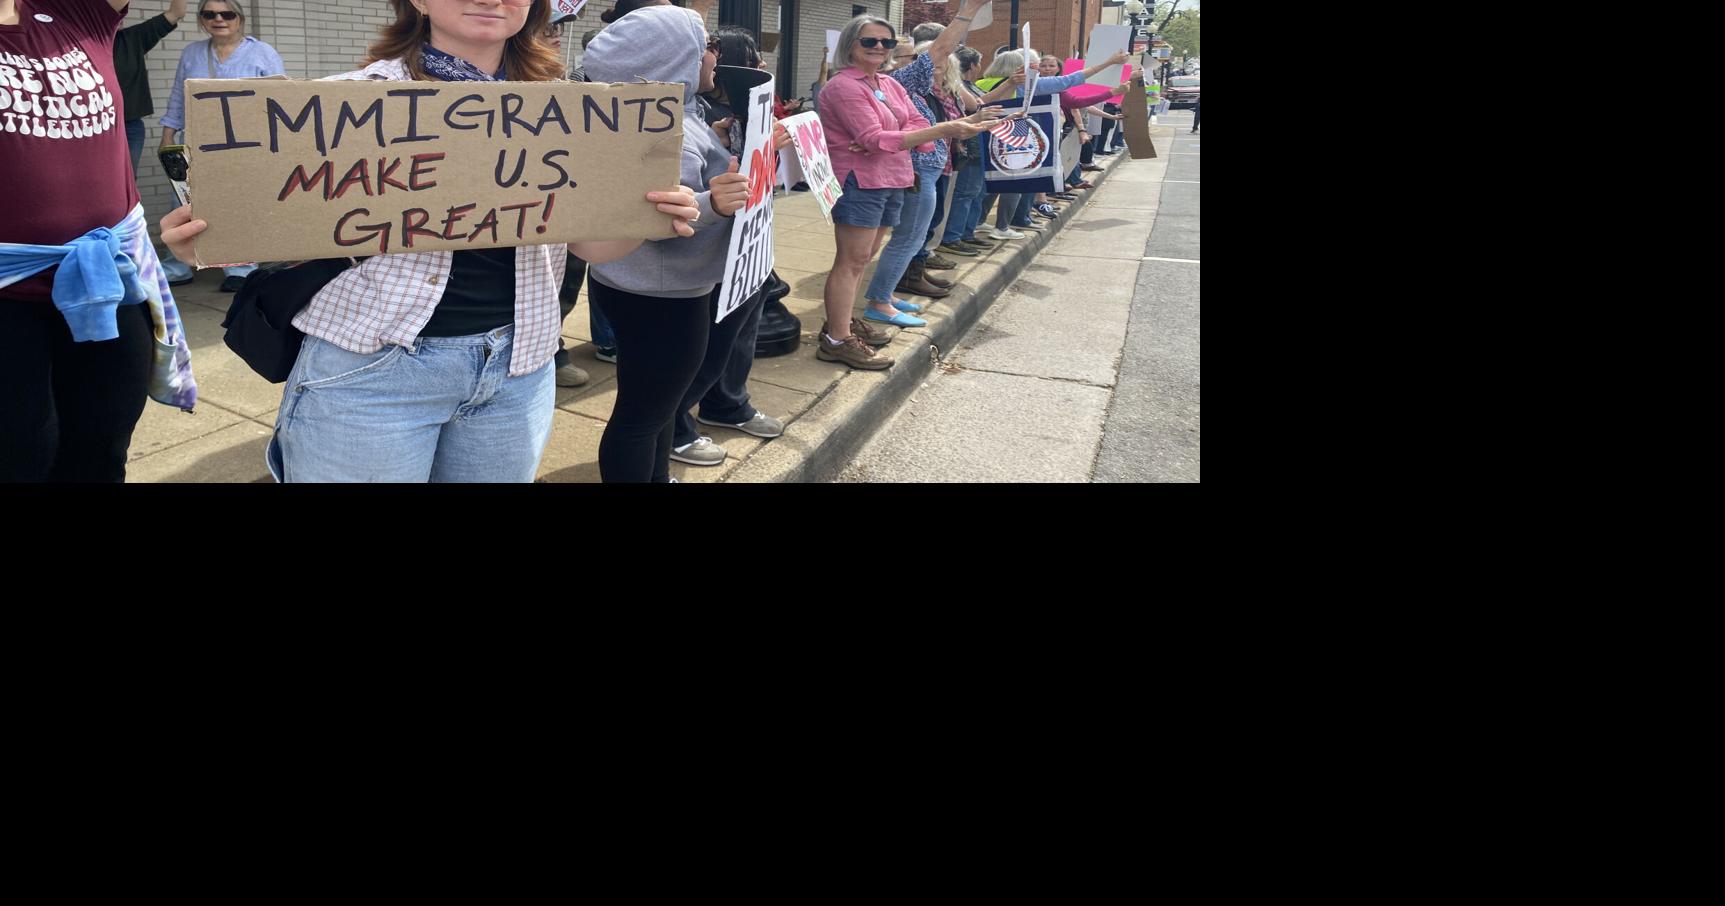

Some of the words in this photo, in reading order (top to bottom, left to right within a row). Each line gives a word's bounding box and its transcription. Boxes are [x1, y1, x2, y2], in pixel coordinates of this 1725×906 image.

[0, 65, 43, 93] RE
[47, 61, 104, 95] NOT
[0, 86, 113, 118] OLITICAL
[0, 107, 116, 138] TTLEFIELDS
[192, 89, 679, 156] IMMIGRANTS
[278, 152, 446, 201] MAKE
[494, 148, 577, 191] U.S.
[333, 192, 555, 254] GREAT!
